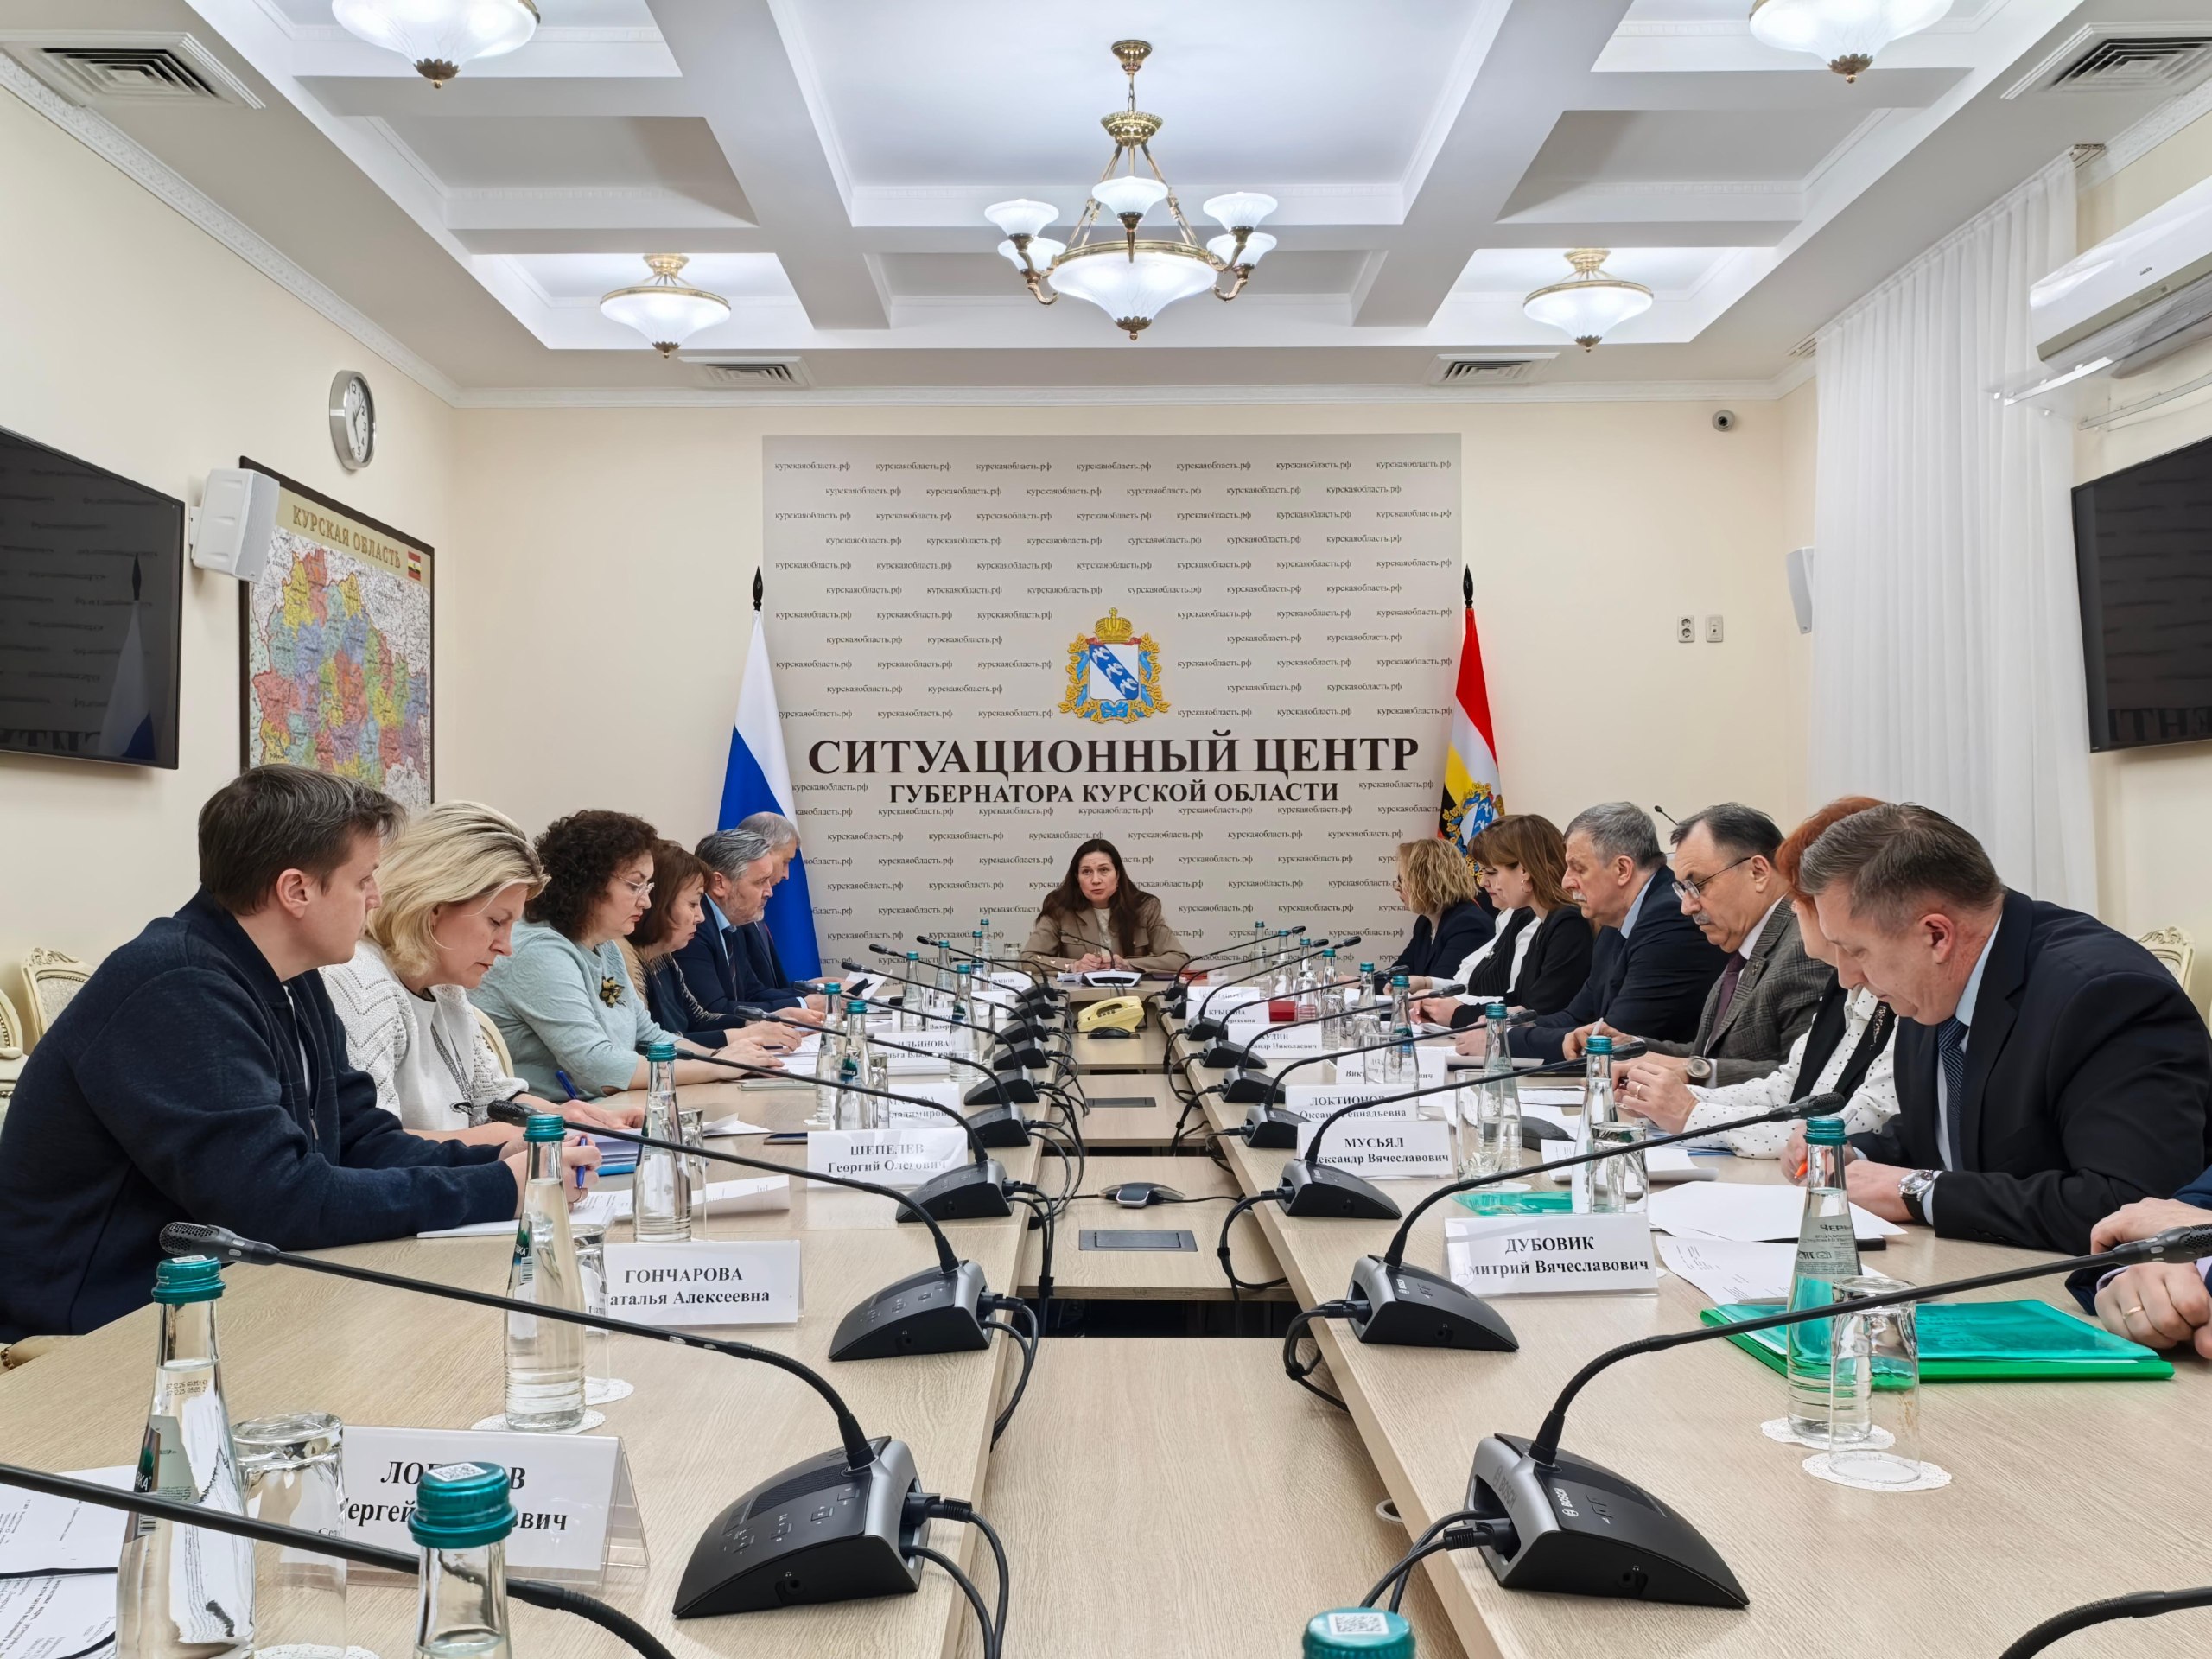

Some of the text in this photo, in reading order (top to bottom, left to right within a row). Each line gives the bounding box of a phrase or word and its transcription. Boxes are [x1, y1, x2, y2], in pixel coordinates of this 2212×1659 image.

[774, 459, 1452, 473] курскаяобласть.рф курскаяобласть.рф курскаяобласть.рф курскаяобласть.рф курскаяобласть.рф курскаяобласть.рф курскаяобласть.рф
[825, 484, 1402, 498] курскаяобласть.рф курскаяобласть.рф курскаяобласть.рф курскаяобласть.рф курскаяобласть.рф курскаяобласть.рф
[775, 509, 1452, 522] курскаяобласть.рф курскаяобласть.рф курскаяобласть.рф курскаяобласть.рф курскаяобласть.рф курскаяобласть.рф курскаяобласть.рф
[292, 505, 402, 569] КУРСКАЯ ОБЛАСТЬ
[825, 534, 1402, 546] курскаяобласть.рф курскаяобласть.рф курскаяобласть.рф курскаяобласть.рф курскаяобласть.рф курскаяобласть.рф
[775, 557, 1452, 571] курскаяобласть.рф курскаяобласть.рф курскаяобласть.рф курскаяобласть.рф курскаяобласть.рф курскаяобласть.рф курскаяобласть.рф
[826, 582, 1402, 595] курскаяобласть.рф курскаяобласть.рф курскаяобласть.рф курскаяобласть.рф курскаяобласть.рф курскаяобласть.рф
[775, 607, 1452, 620] курскаяобласть.рф курскаяобласть.рф курскаяобласть.рф курскаяобласть.рф курскаяобласть.рф курскаяобласть.рф
[826, 632, 1402, 645] курскаяобласть.рф курскаяобласть.рф курскаяобласть.рф курскаяобласть.рф
[775, 656, 1452, 671] курскаяобласть.рф курскаяобласть.рф курскаяобласть.рф курскаяобласть.рф курскаяобласть.рф курскаяобласть.рф
[826, 681, 1402, 695] курскаяобласть.рф курскаяобласть.рф курскаяобласть.рф курскаяобласть.рф
[877, 709, 954, 720] курскаяобласть.рф
[977, 709, 1054, 720] курскаяобласть.рф
[1177, 707, 1253, 719] курскаяобласть.рф
[1276, 707, 1352, 718] курскаяобласть.рф
[1376, 706, 1453, 717] курскаяобласть.рф
[808, 729, 1420, 780] СИТУАЦИОННЫЙ ЦЕНТР
[890, 779, 1338, 804] ГУБЕРНАТОРА КУРСКОЙ ОБЛАСТИ
[1358, 779, 1434, 791] курскаяобласть.рф
[794, 804, 1440, 818] каяобласть.рф курскаяобласть.рф курскаяобласть.рф курскаяобласть.рф курскаяобласть.рф курскаяобласть.рф курскаяобласть
[827, 831, 904, 842] курскаяобласть.рф
[928, 831, 1004, 842] курскаяобласть.рф
[1128, 830, 1204, 841] курскаяобласть.рф
[1227, 830, 1303, 840] курскаяобласть.рф
[1327, 829, 1404, 840] курскаяобласть.рф
[804, 854, 1354, 867] яобласть.рф курскаяобласть.рф курскаяобласть.рф курскаяобласть.рф курскаяобласть.рф
[827, 880, 904, 892] курскаяобласть.рф
[928, 880, 1005, 891] курскаяобласть.рф
[1228, 879, 1304, 889] курскаяобласть.рф
[878, 905, 954, 916] курскаяобласть.рф
[1178, 903, 1254, 914] курскаяобласть.рф
[1278, 903, 1354, 914] курскаяобласть.рф
[827, 930, 904, 941] курскаяобласть.рф
[1328, 928, 1405, 939] курскаяобласть.рф
[850, 1143, 925, 1156] ШЕПЕЛЕВ
[1344, 1137, 1405, 1148] МУСЬЯЛ
[1318, 1152, 1450, 1166] ександр Вячеславович
[828, 1160, 880, 1175] Георгий
[1505, 1236, 1595, 1255] ДУБОВИК
[1535, 1258, 1649, 1274] Вячеславович
[625, 1267, 743, 1284] ГОНЧАРОВА
[610, 1290, 770, 1306] аталья Алексеевна
[346, 1499, 416, 1527] ергей
